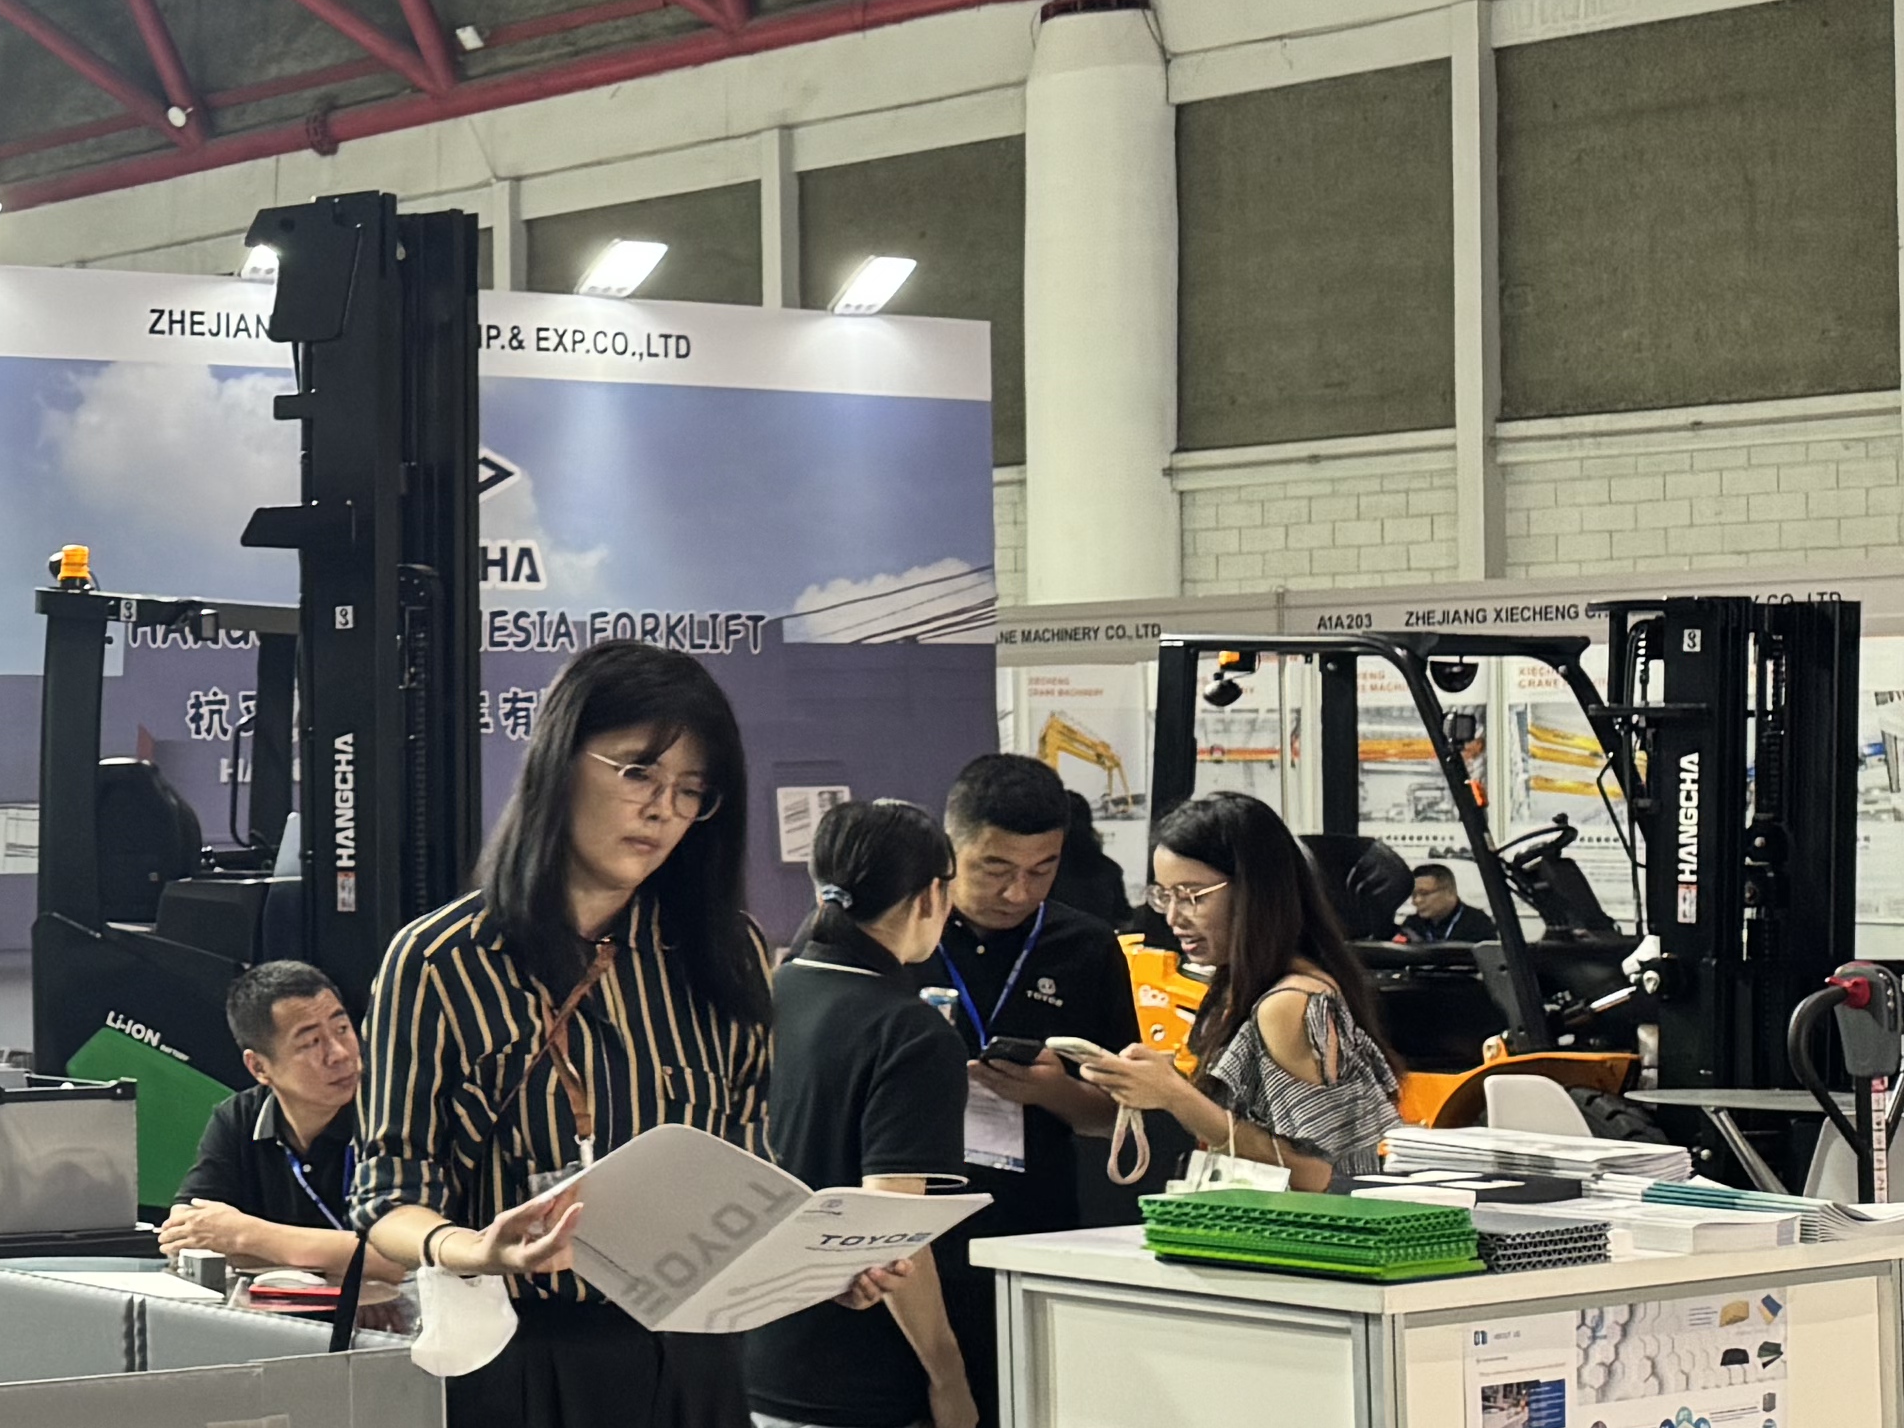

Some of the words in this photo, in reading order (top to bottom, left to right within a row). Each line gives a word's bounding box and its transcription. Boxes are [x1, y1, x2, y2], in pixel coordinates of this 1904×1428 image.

[148, 308, 271, 341] ZHEJIAN
[591, 613, 769, 654] FORKLIFT
[1021, 626, 1100, 644] MACHINERY
[1105, 624, 1133, 641] CO.,
[1135, 623, 1163, 643] LTD
[1316, 612, 1374, 632] A1A203
[1402, 608, 1487, 632] ZHEJIANG
[1493, 604, 1579, 623] XIECHENG
[333, 732, 357, 869] HANGCHA
[1677, 751, 1700, 883] HANGCHA
[105, 1010, 162, 1048] Li-ION
[819, 1231, 933, 1248] TOYOE
